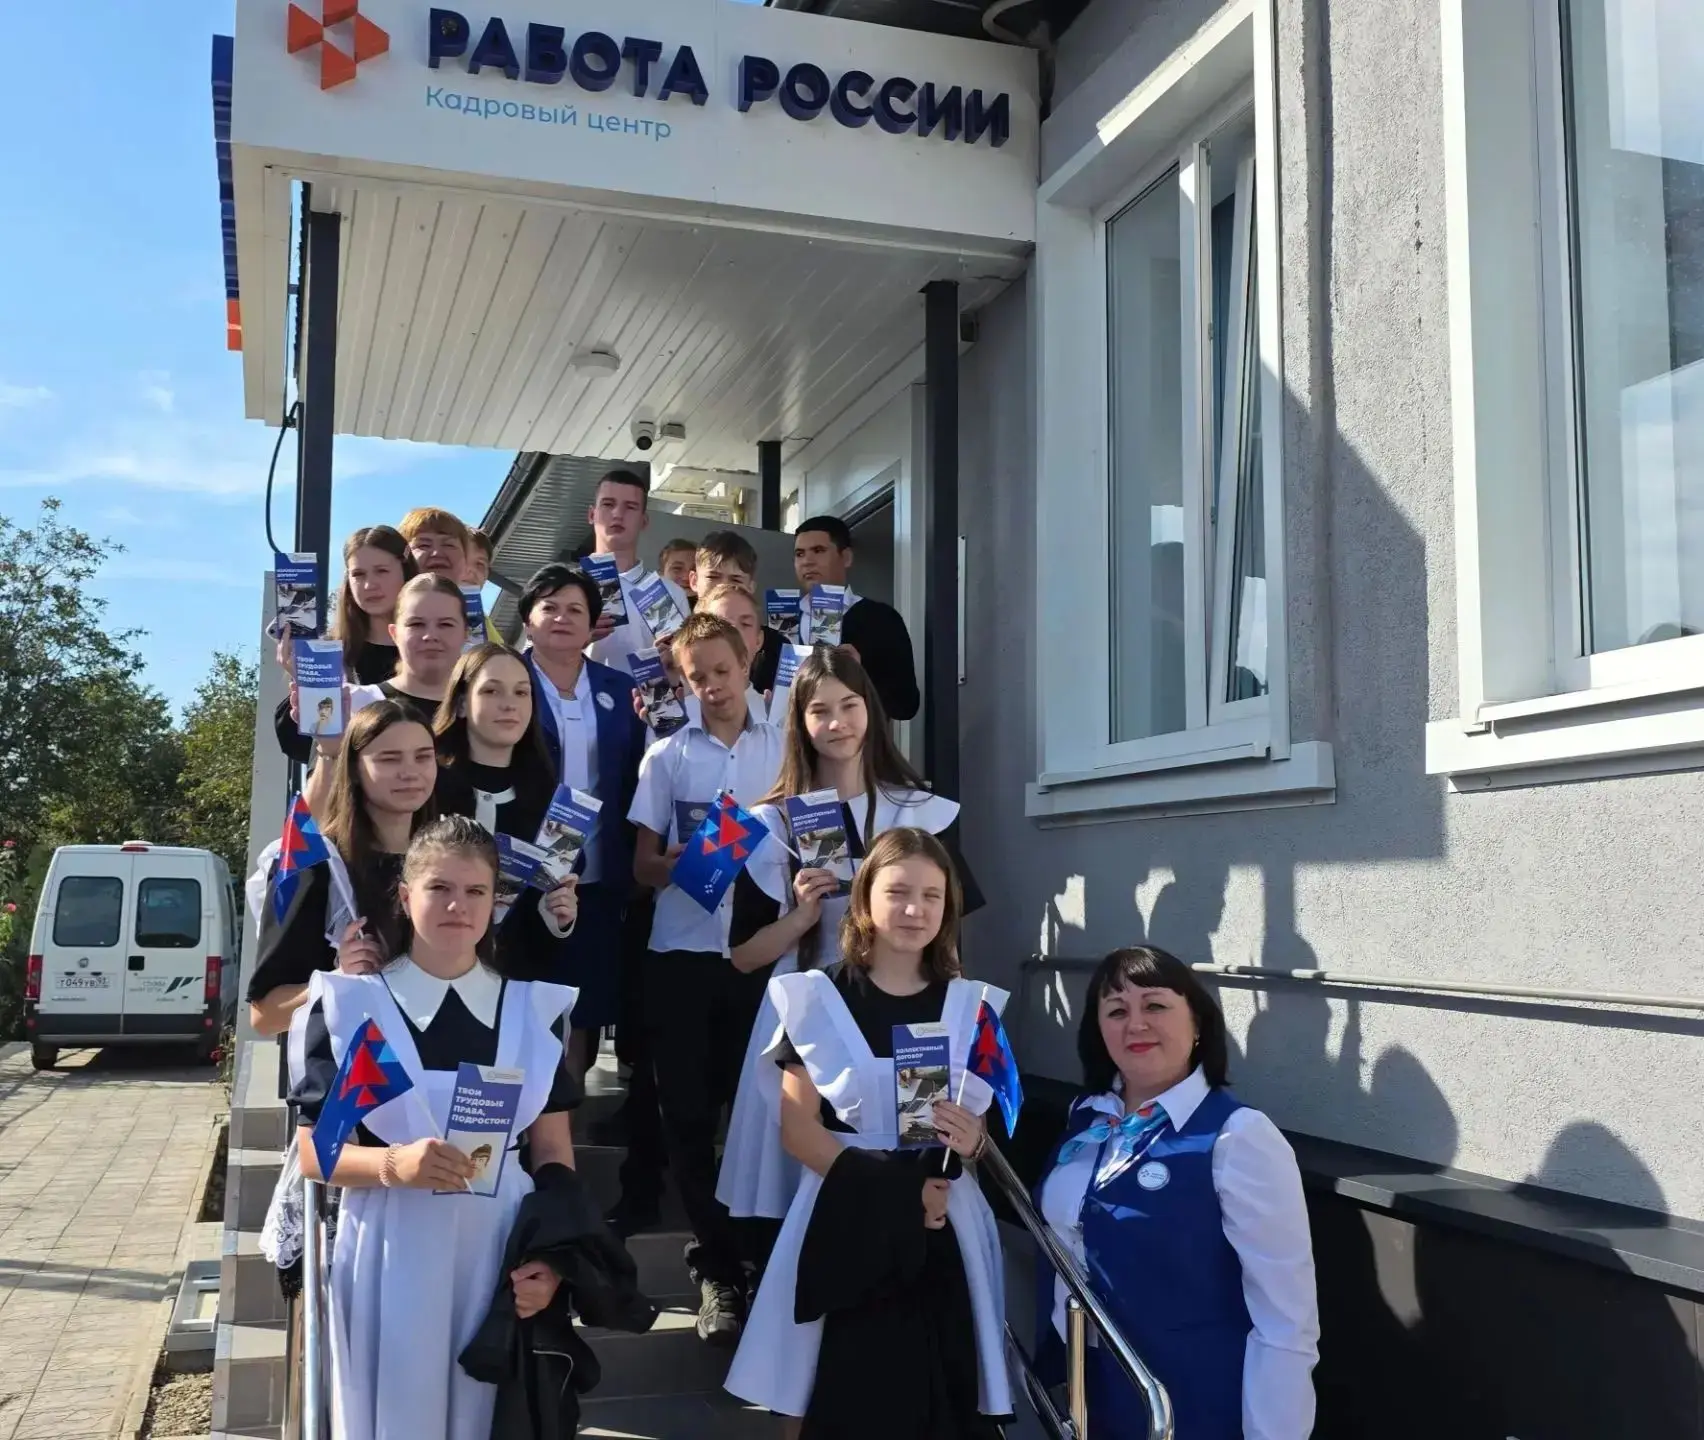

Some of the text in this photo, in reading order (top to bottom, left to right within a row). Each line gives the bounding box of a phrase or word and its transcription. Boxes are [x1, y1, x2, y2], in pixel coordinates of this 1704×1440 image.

[427, 7, 1010, 148] РАБОТА РОССИИ
[426, 86, 672, 141] Кадровый центр
[896, 1044, 944, 1054] КОЛЛЕКТИВНЫЙ
[896, 1053, 924, 1061] ДОГОВОР
[457, 1086, 482, 1097] ТВОИ
[455, 1095, 505, 1107] ТРУДОВЫЕ
[453, 1105, 486, 1116] ПРАВА,
[451, 1114, 511, 1125] ПОДРОСТОК!
